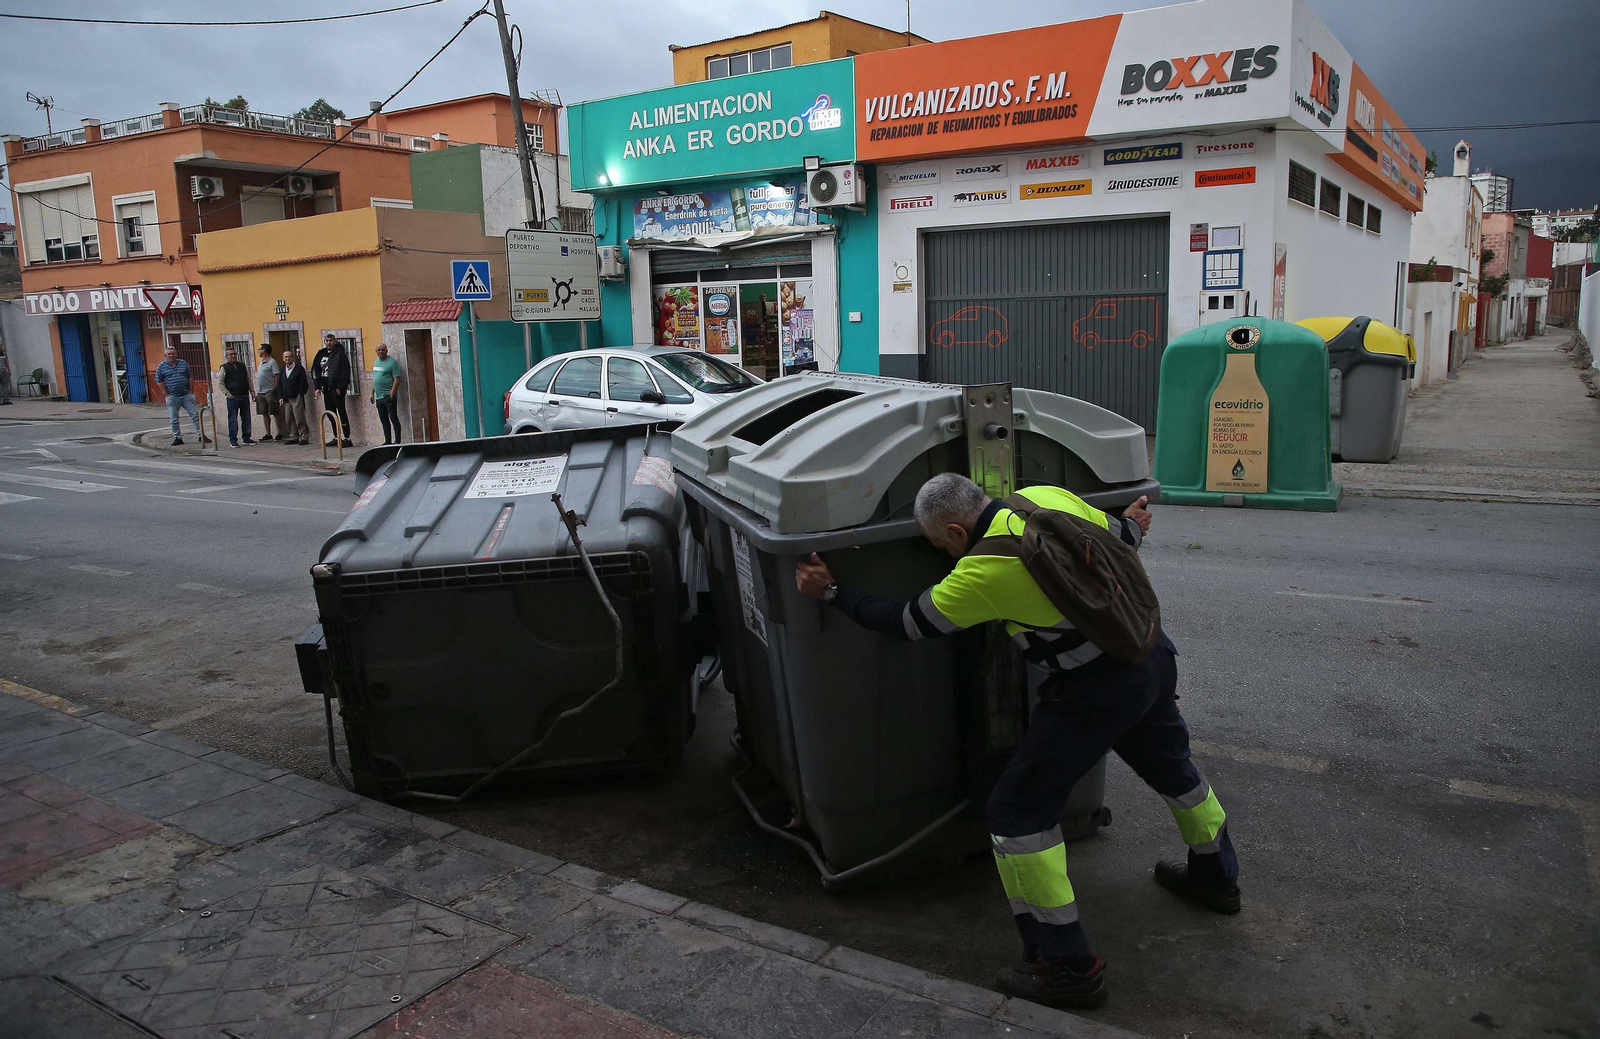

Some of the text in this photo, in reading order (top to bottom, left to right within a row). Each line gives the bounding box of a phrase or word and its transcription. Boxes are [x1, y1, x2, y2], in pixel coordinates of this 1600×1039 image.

[1120, 45, 1280, 96] BOXXES
[629, 90, 772, 130] ALIMENTACION
[870, 104, 1078, 141] REPARACION DE NEUMATICOS Y EQUILIBRADOS
[623, 117, 803, 159] ANKA ER GORDO
[1106, 146, 1179, 162] GOODYEAR
[1196, 140, 1255, 154] Firestone
[956, 163, 1004, 175] ROADX
[1025, 154, 1080, 170] MAXXIS
[899, 172, 936, 181] MICHELIN
[1107, 176, 1180, 190] BRIDGESTONE
[1198, 171, 1244, 184] Continental
[749, 186, 795, 199] full per
[1036, 183, 1085, 194] DUNLOP
[642, 194, 700, 209] ANKA ER GORDO
[890, 195, 933, 210] PIRELLI
[967, 191, 1008, 202] TAURUS
[750, 203, 766, 212] pure
[768, 200, 794, 210] energy
[665, 210, 697, 221] Enerdrink
[698, 209, 708, 217] de
[709, 207, 728, 216] venta
[26, 291, 80, 313] TODO
[90, 286, 187, 310] PINTUA
[1214, 399, 1264, 410] ecovidrio
[1213, 433, 1248, 442] REDUCIR
[504, 460, 546, 468] algesa
